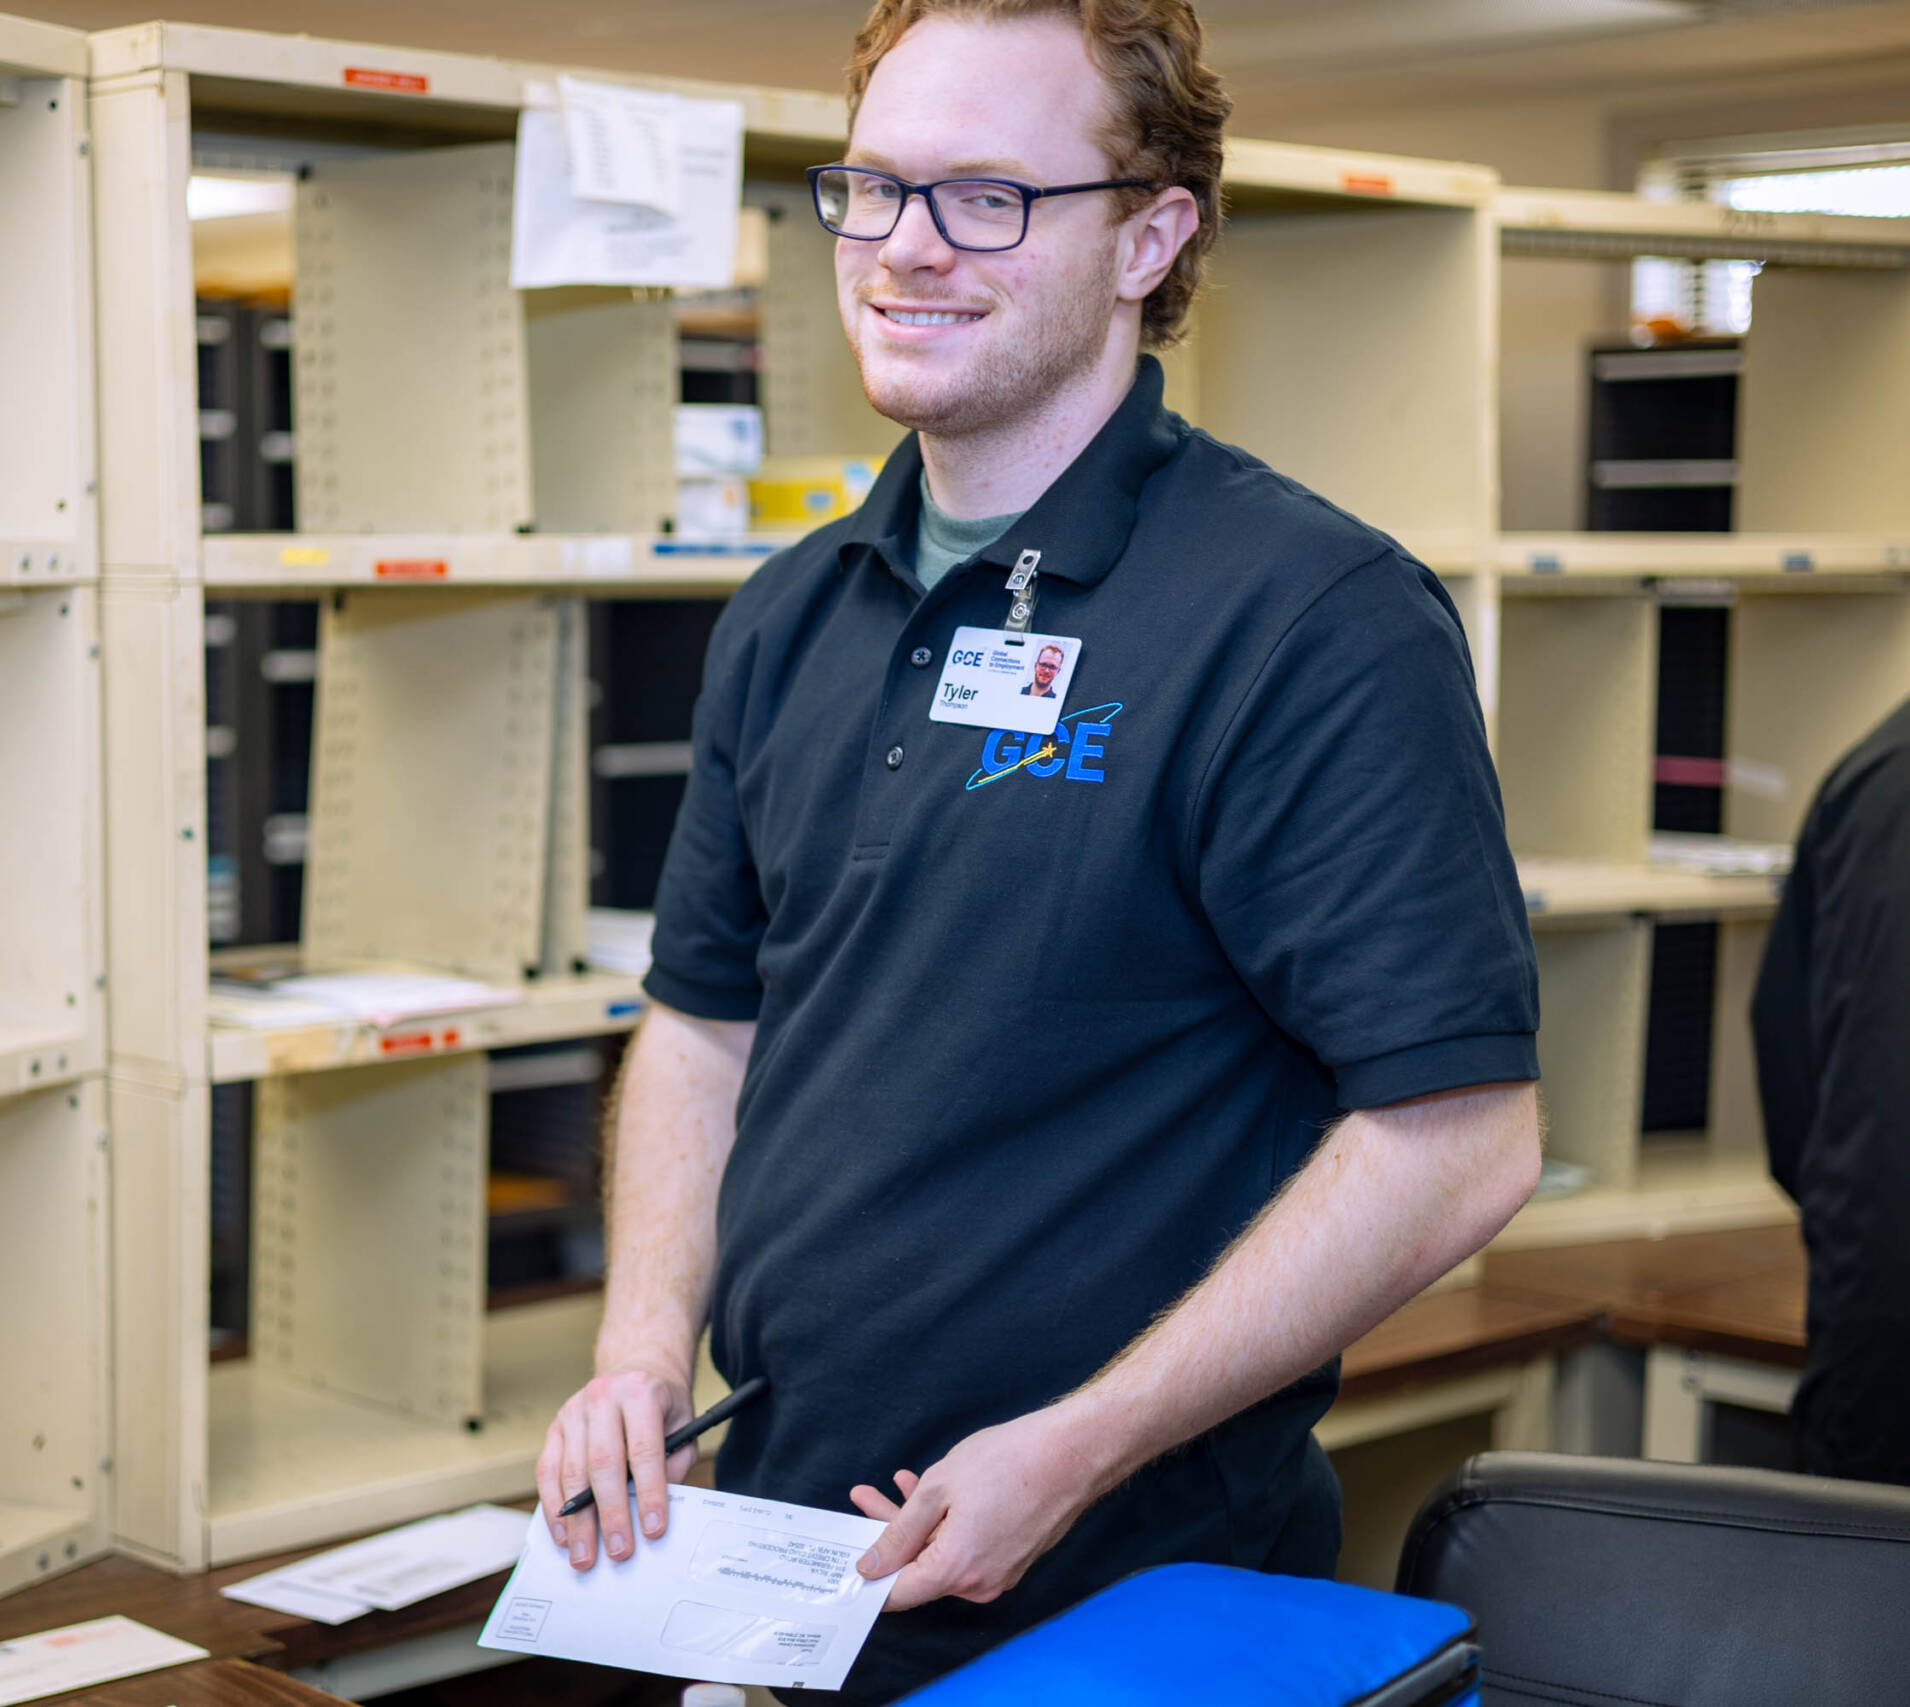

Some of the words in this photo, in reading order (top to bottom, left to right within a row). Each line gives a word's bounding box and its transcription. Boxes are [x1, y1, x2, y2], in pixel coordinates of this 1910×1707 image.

[952, 650, 984, 667] GCE
[991, 656, 1020, 664] Connections
[944, 683, 978, 702] Tyler
[940, 700, 968, 708] Thompson
[981, 721, 1112, 783] GCE
